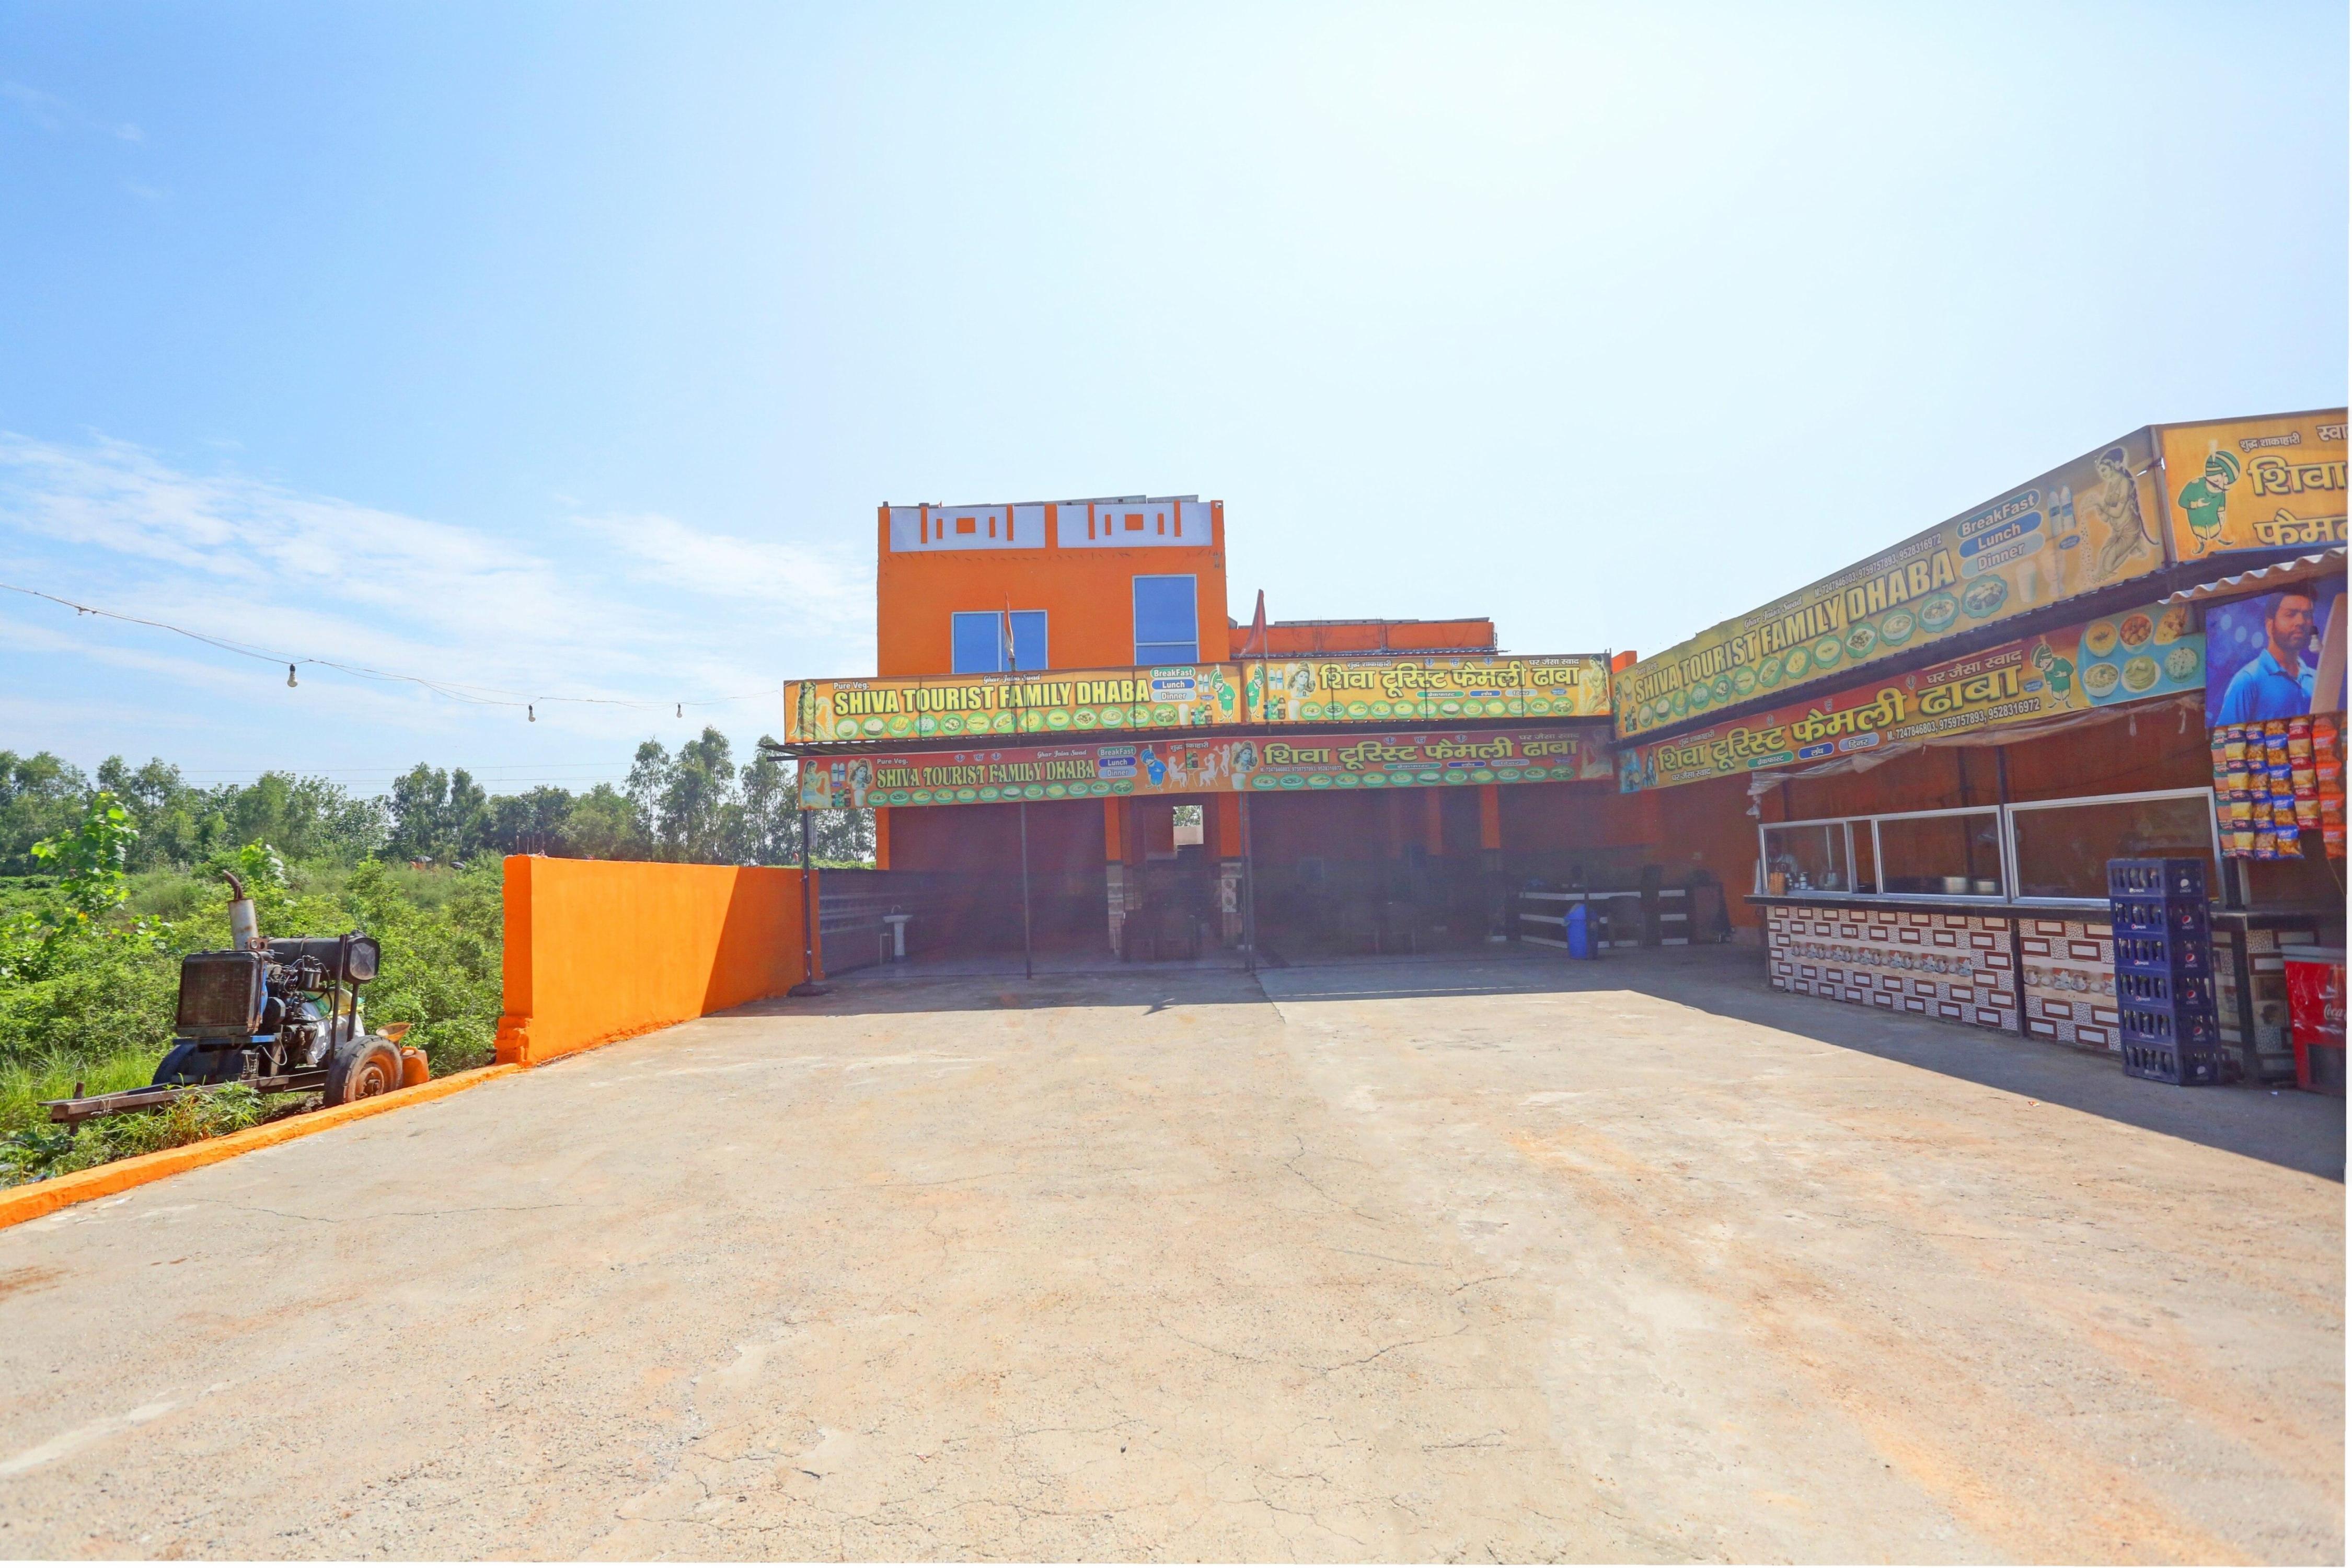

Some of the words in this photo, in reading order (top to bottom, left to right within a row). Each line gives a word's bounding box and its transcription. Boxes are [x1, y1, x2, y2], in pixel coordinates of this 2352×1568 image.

[2240, 439, 2258, 452] शुद्ध
[2259, 431, 2300, 447] शाकाहारी
[2316, 423, 2347, 441] स्वा
[2247, 455, 2346, 496] शिवा
[1962, 493, 2035, 536] BreakFast
[2253, 508, 2347, 546] फैम
[1978, 522, 2021, 550] Lunch
[1859, 555, 1898, 580] 9759757893,
[1899, 533, 1942, 562] 9528316972
[1978, 543, 2025, 571] Dinner
[1635, 664, 1679, 704] SHIVA
[1679, 630, 1756, 686] TOURIST
[1760, 594, 1840, 656] FAMILY
[1845, 548, 1956, 624] DHABA
[1744, 617, 1760, 631] Ghar
[1762, 608, 1781, 622] Jaisa
[1782, 595, 1803, 613] Swad
[983, 675, 1000, 684] Ghar
[1001, 674, 1020, 683] Jaisa
[1154, 668, 1192, 677] BreakFast
[1319, 662, 1376, 689] शिवा
[1380, 662, 1449, 698] टूरिस्ट
[1452, 660, 1527, 688] फैमली
[1532, 666, 1580, 686] ढाबा
[1635, 666, 1646, 675] Pure
[1927, 672, 1946, 684] घर
[1948, 660, 1981, 678] जैसा
[1985, 650, 2022, 668] स्वाद
[834, 689, 900, 716] SHIVA
[902, 685, 994, 712] TOURIST
[998, 682, 1071, 708] FAMILY
[1077, 679, 1150, 705] DHABA
[1161, 691, 1186, 700] Dinner
[1162, 681, 1185, 689] Lunch
[1657, 744, 1705, 772] शिवा
[1710, 727, 1786, 771] टूरिस्ट
[1791, 687, 1907, 742] फैमली
[1918, 665, 2022, 715] ढाबा
[1887, 731, 1894, 741] M.
[1896, 720, 1938, 739] 7247846803,
[1940, 709, 1987, 731] 9759757893,
[1988, 698, 2040, 721] 9528316972
[1263, 742, 1331, 765] शिवा
[1337, 741, 1419, 770] टूरिस्ट
[1424, 737, 1515, 759] फैमली
[1521, 740, 1578, 757] ढाबा
[1811, 747, 1824, 756] लंच
[1849, 739, 1869, 749] डिनर
[877, 768, 920, 788] SHIVA
[923, 765, 985, 786] TOURIST
[989, 762, 1042, 783] FAMILY
[1046, 759, 1096, 780] DHABA
[1696, 767, 1711, 777] स्वाद
